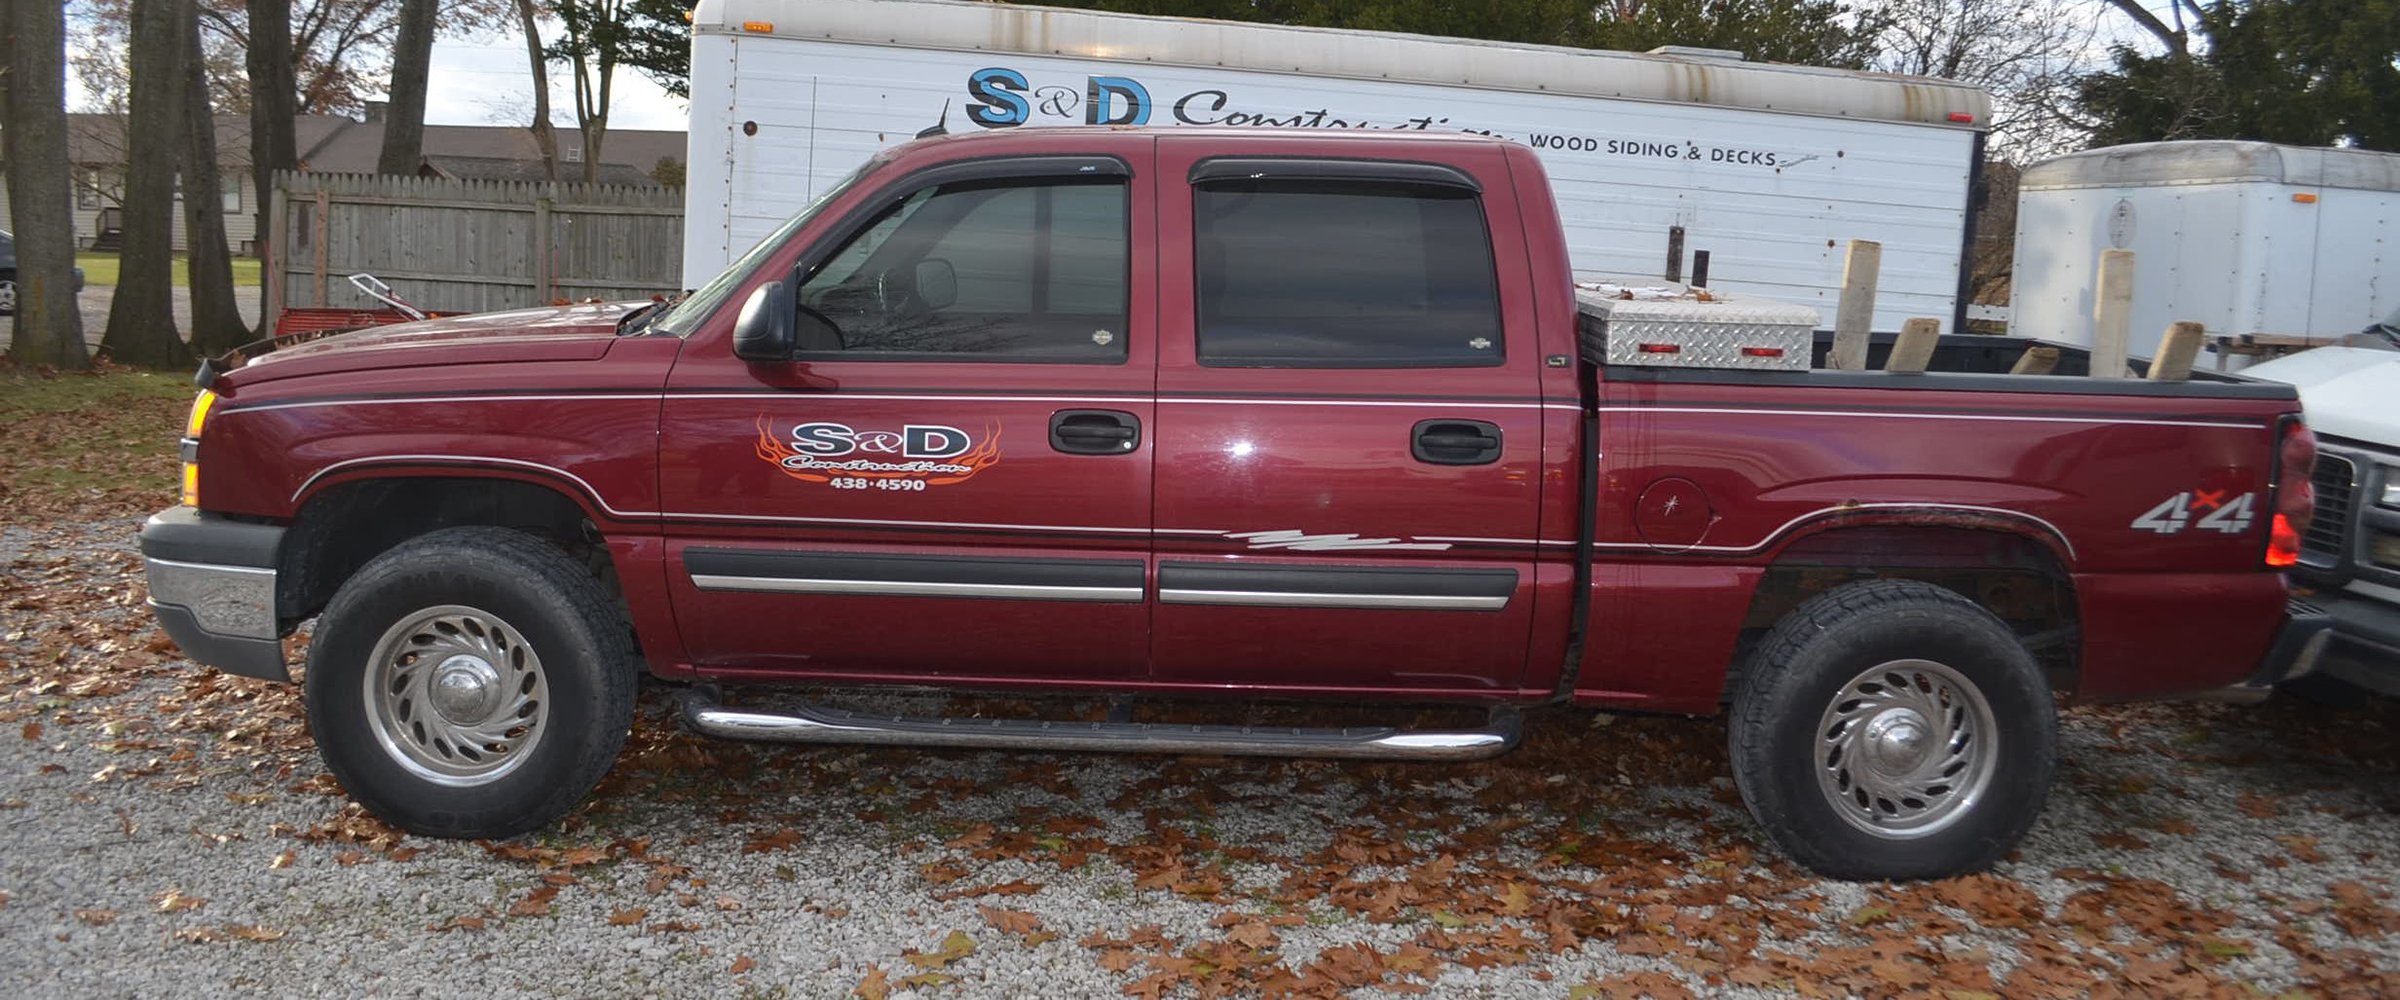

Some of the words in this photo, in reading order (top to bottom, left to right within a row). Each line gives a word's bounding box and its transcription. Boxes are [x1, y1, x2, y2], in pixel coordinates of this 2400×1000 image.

[1529, 133, 1598, 152] WOOD
[1607, 140, 1679, 159] SIDING
[1687, 146, 1702, 161] &
[1711, 148, 1776, 167] DECKS
[781, 455, 972, 473] Construction
